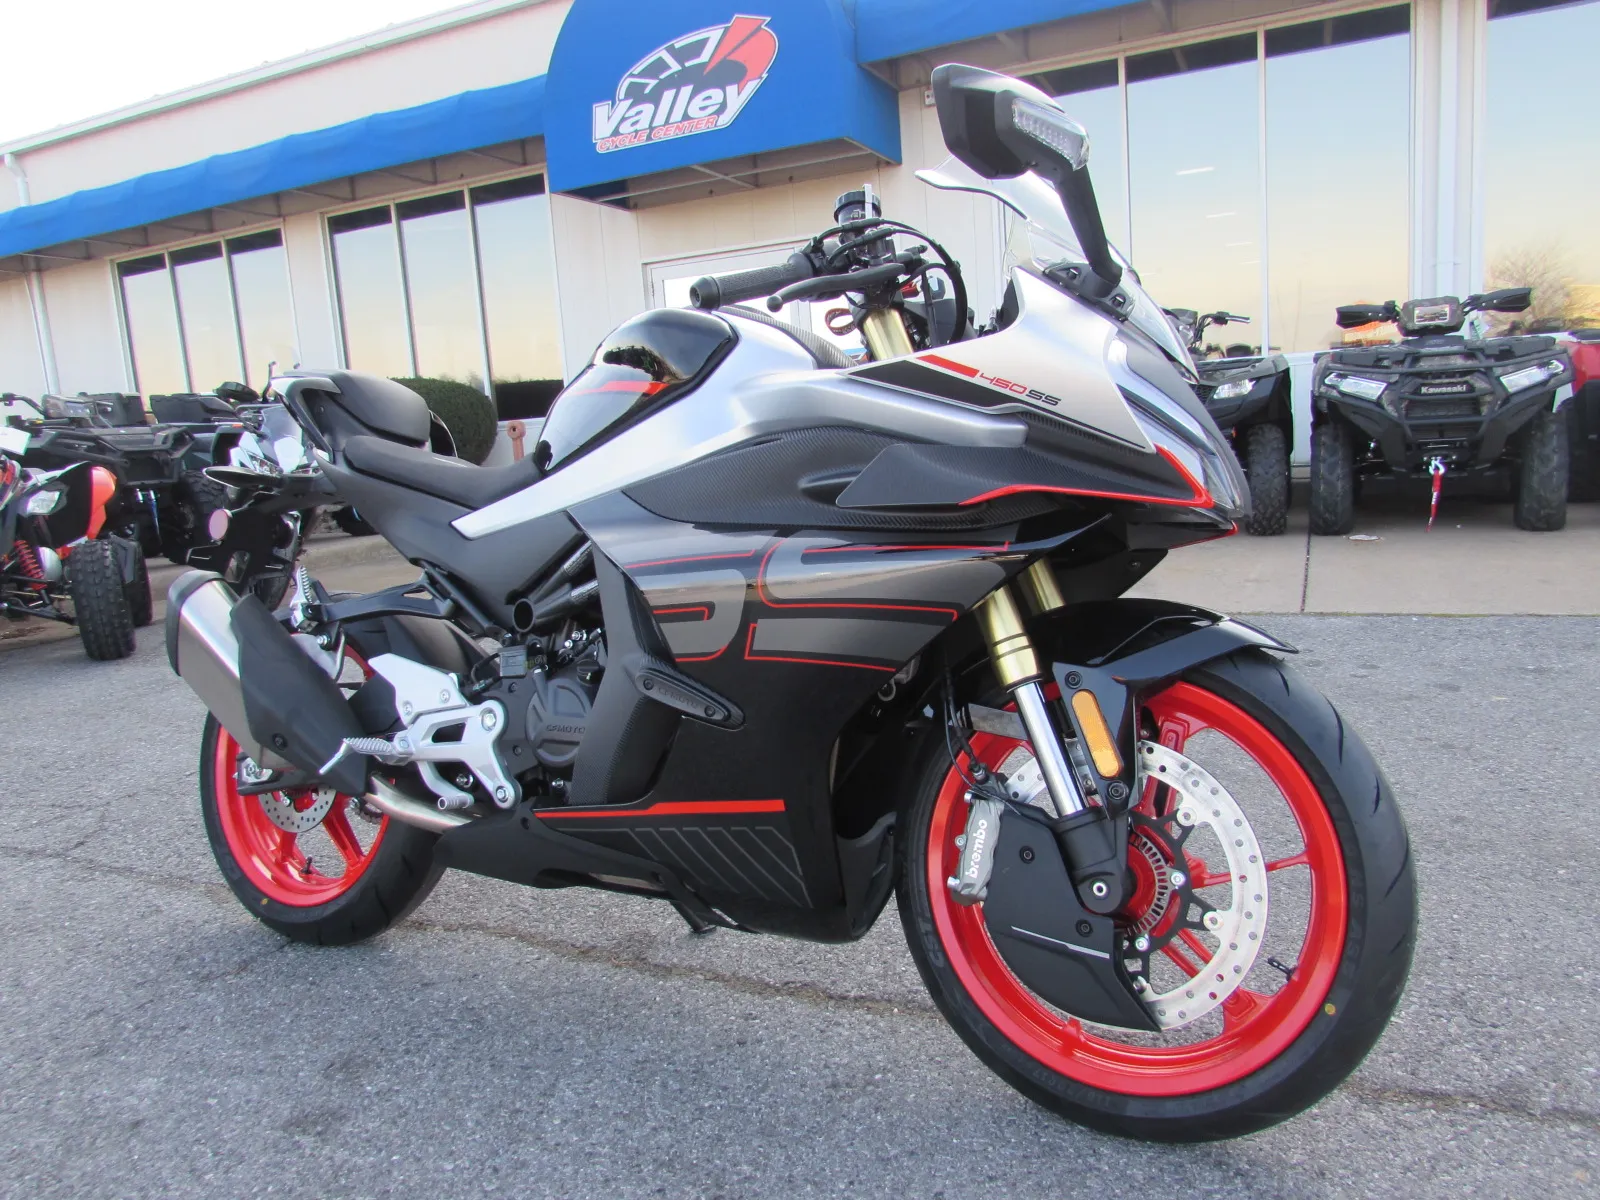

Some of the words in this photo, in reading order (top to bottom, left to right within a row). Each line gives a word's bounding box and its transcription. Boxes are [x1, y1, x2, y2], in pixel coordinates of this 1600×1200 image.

[594, 77, 763, 140] Valley
[598, 130, 649, 151] CYCLE
[652, 115, 717, 139] CENTER
[1421, 384, 1467, 394] Kawasaki
[546, 724, 586, 734] CFMOTO
[965, 819, 988, 879] brembo
